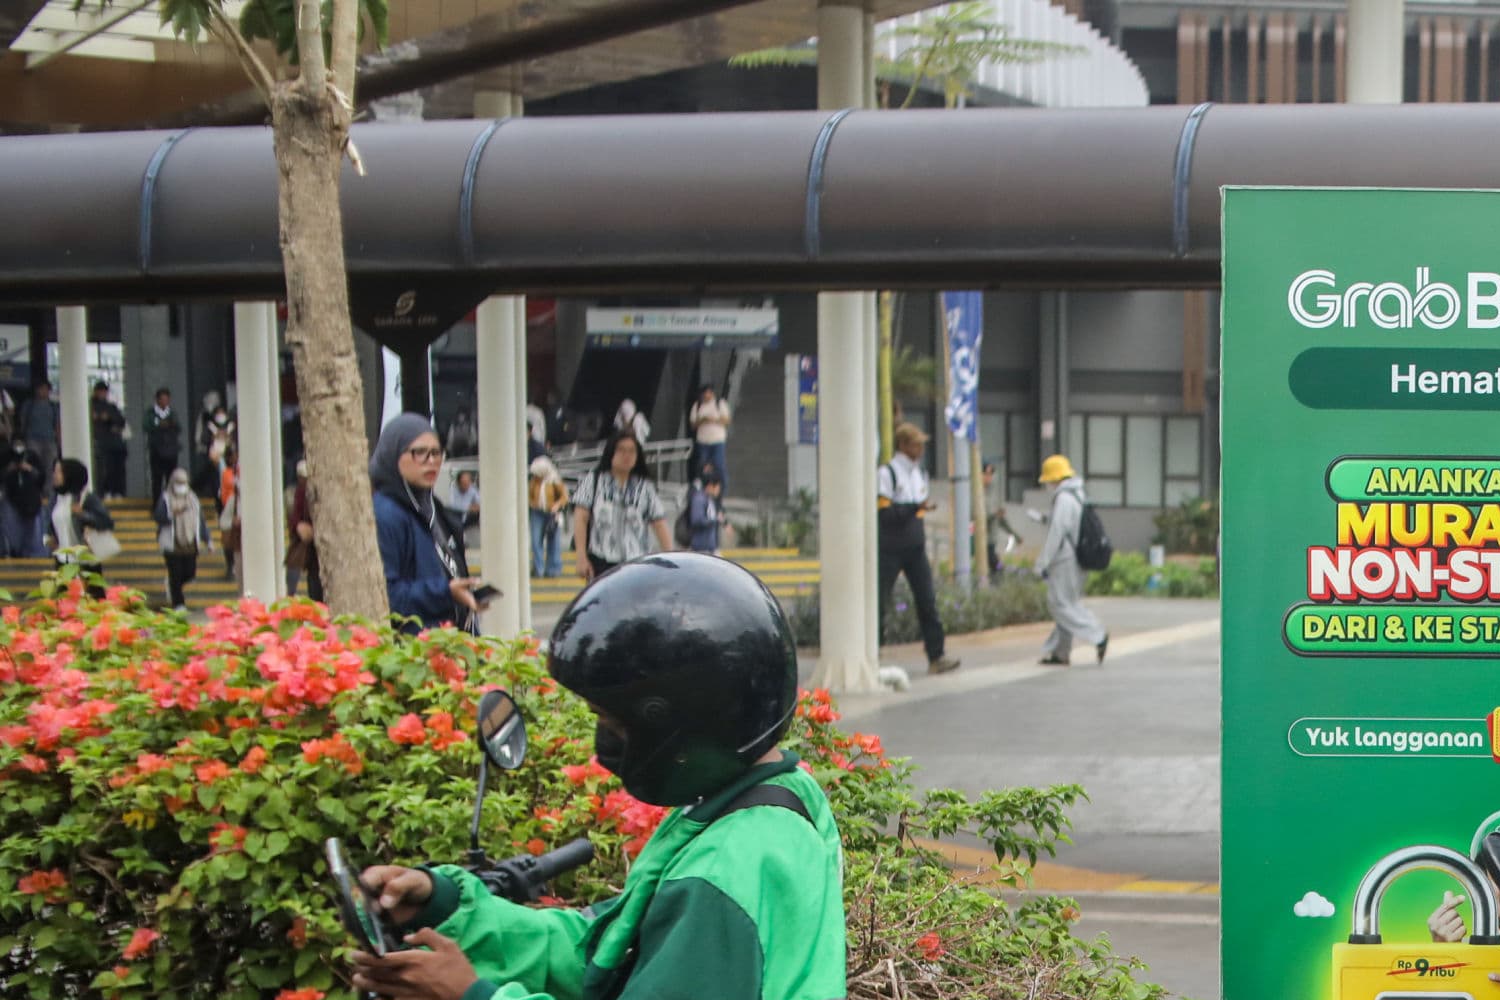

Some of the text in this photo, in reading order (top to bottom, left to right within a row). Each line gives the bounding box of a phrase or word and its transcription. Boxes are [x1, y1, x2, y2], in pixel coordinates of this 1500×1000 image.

[1303, 614, 1378, 641] DARI
[1385, 615, 1407, 640] &
[1413, 616, 1453, 641] KE
[1306, 727, 1484, 751] Yuk langganan
[1397, 958, 1455, 978] Rp 9 ribu
